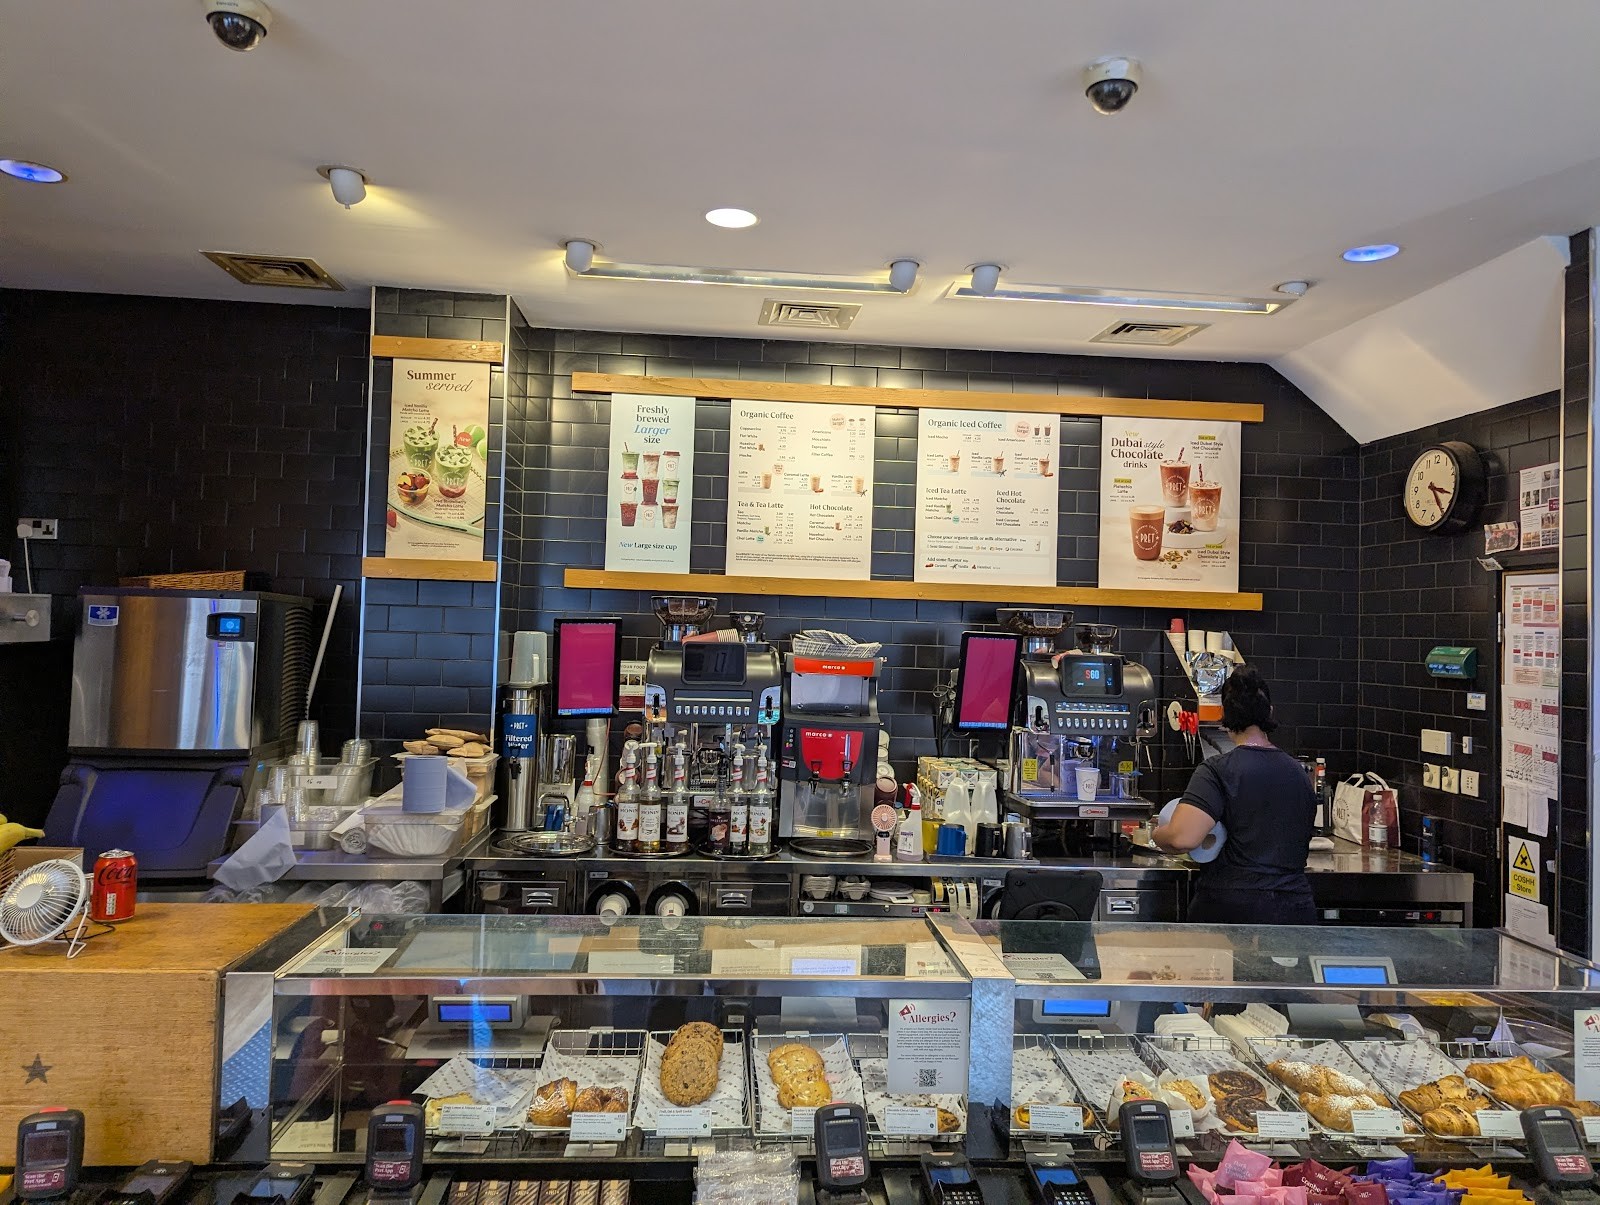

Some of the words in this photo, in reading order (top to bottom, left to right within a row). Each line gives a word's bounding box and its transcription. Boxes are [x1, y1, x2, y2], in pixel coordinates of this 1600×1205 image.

[407, 370, 456, 380] Summer
[426, 380, 474, 392] served
[637, 405, 669, 416] Freshly
[740, 410, 769, 419] Organic
[636, 414, 670, 423] brewed
[928, 419, 958, 428] Organic
[634, 424, 671, 436] Larger
[1111, 438, 1142, 447] Dubai
[1144, 440, 1165, 451] style
[1111, 449, 1163, 460] Chocolate
[414, 459, 428, 467] PRET
[1434, 455, 1440, 464] 12
[1426, 460, 1430, 469] 11
[1418, 472, 1424, 480] 10
[1451, 467, 1455, 476] 2
[1170, 482, 1182, 491] PRET
[1414, 487, 1418, 495] 9
[1416, 500, 1420, 509] 8
[1199, 506, 1212, 515] PRET
[1420, 510, 1426, 520] 7
[1431, 512, 1435, 521] 6
[1140, 534, 1155, 543] PRET
[1085, 670, 1099, 679] S60
[1514, 874, 1535, 886] COSHH
[1516, 884, 1531, 894] Store
[909, 1011, 956, 1024] Allergies?
